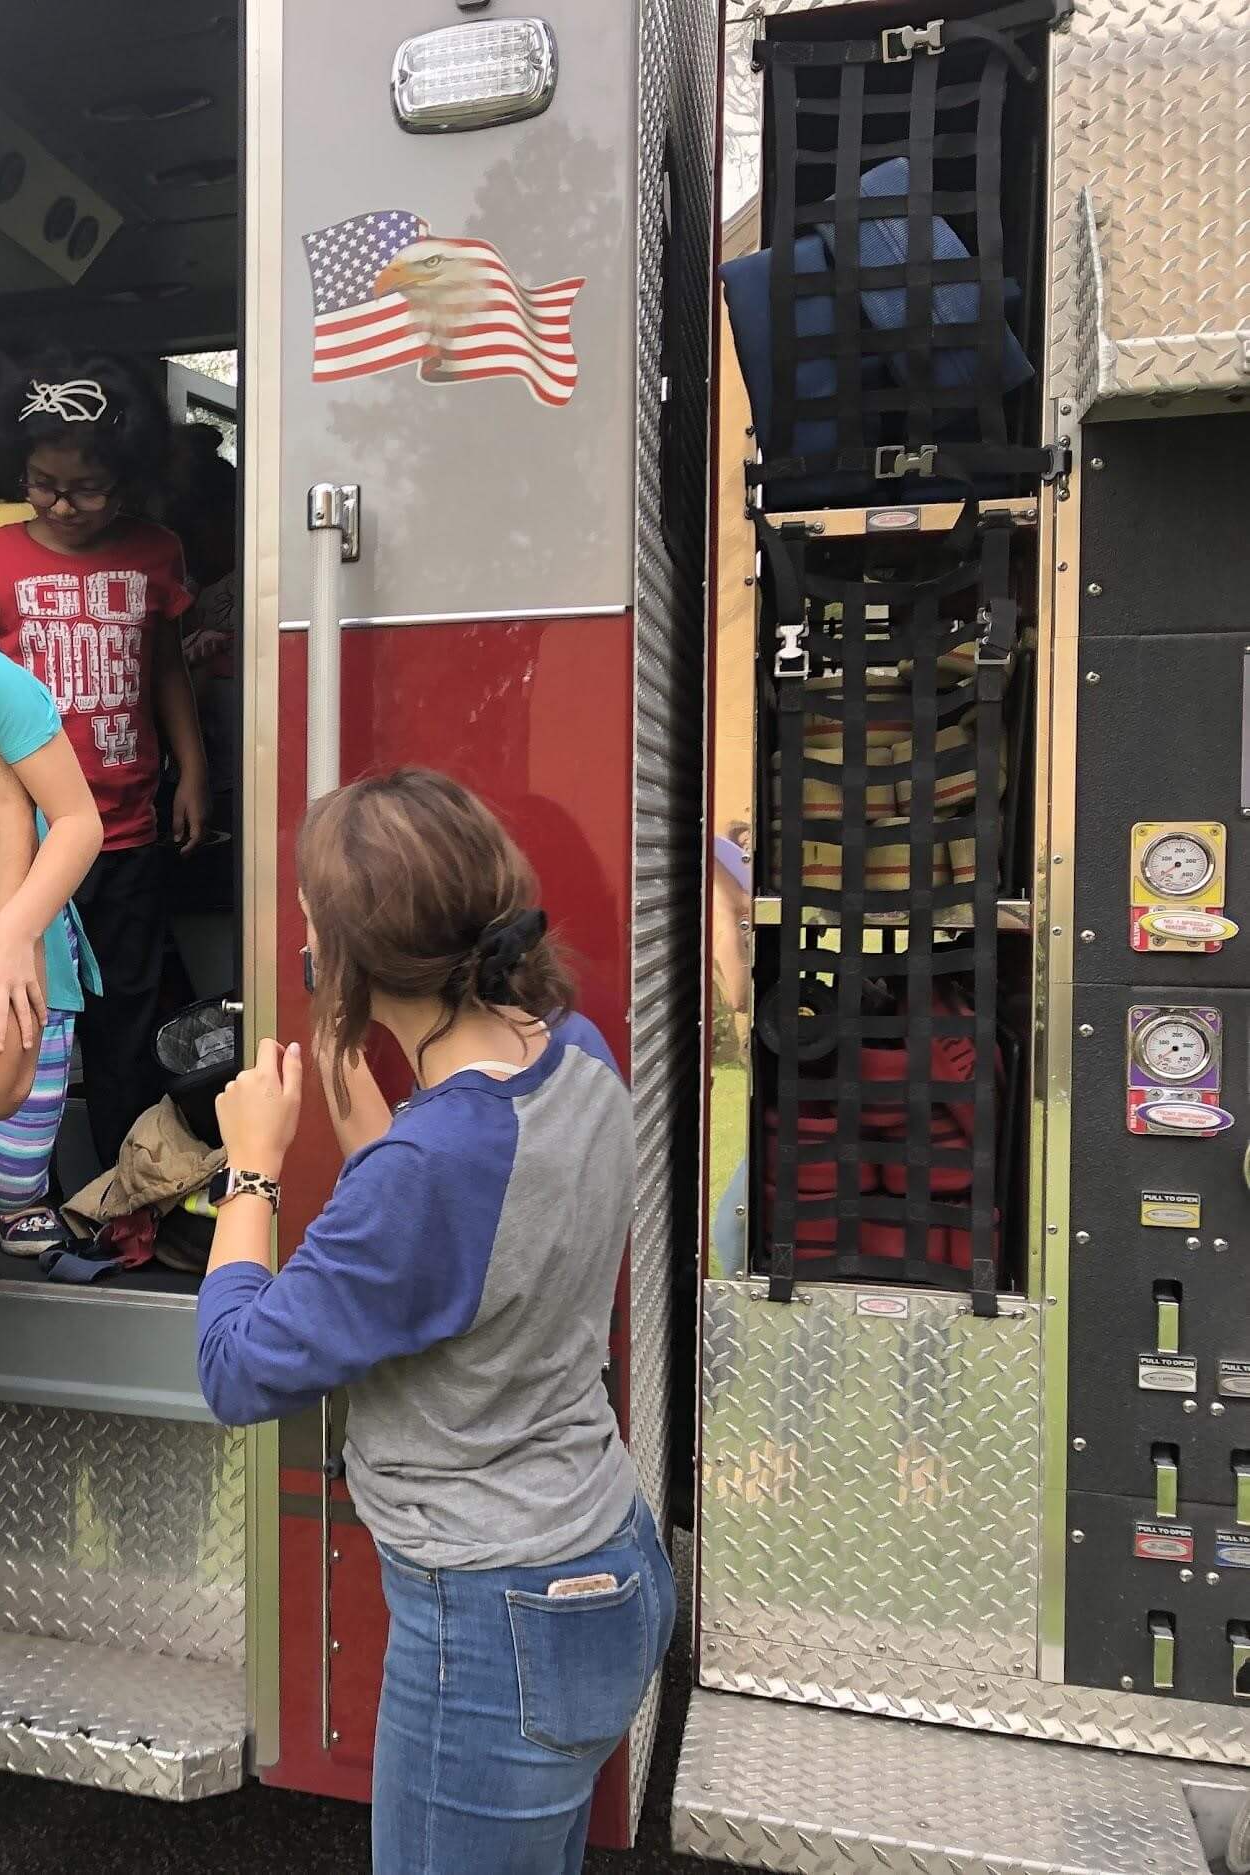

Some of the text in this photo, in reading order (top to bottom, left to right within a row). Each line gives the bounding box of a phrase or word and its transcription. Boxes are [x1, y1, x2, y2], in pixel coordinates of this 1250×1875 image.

[15, 570, 148, 626] GO
[91, 713, 138, 768] UH
[1221, 1363, 1243, 1372] PULL
[1137, 1525, 1158, 1533] PULL
[1169, 1528, 1191, 1537] OPEN
[1217, 1534, 1250, 1543] PULL TO
